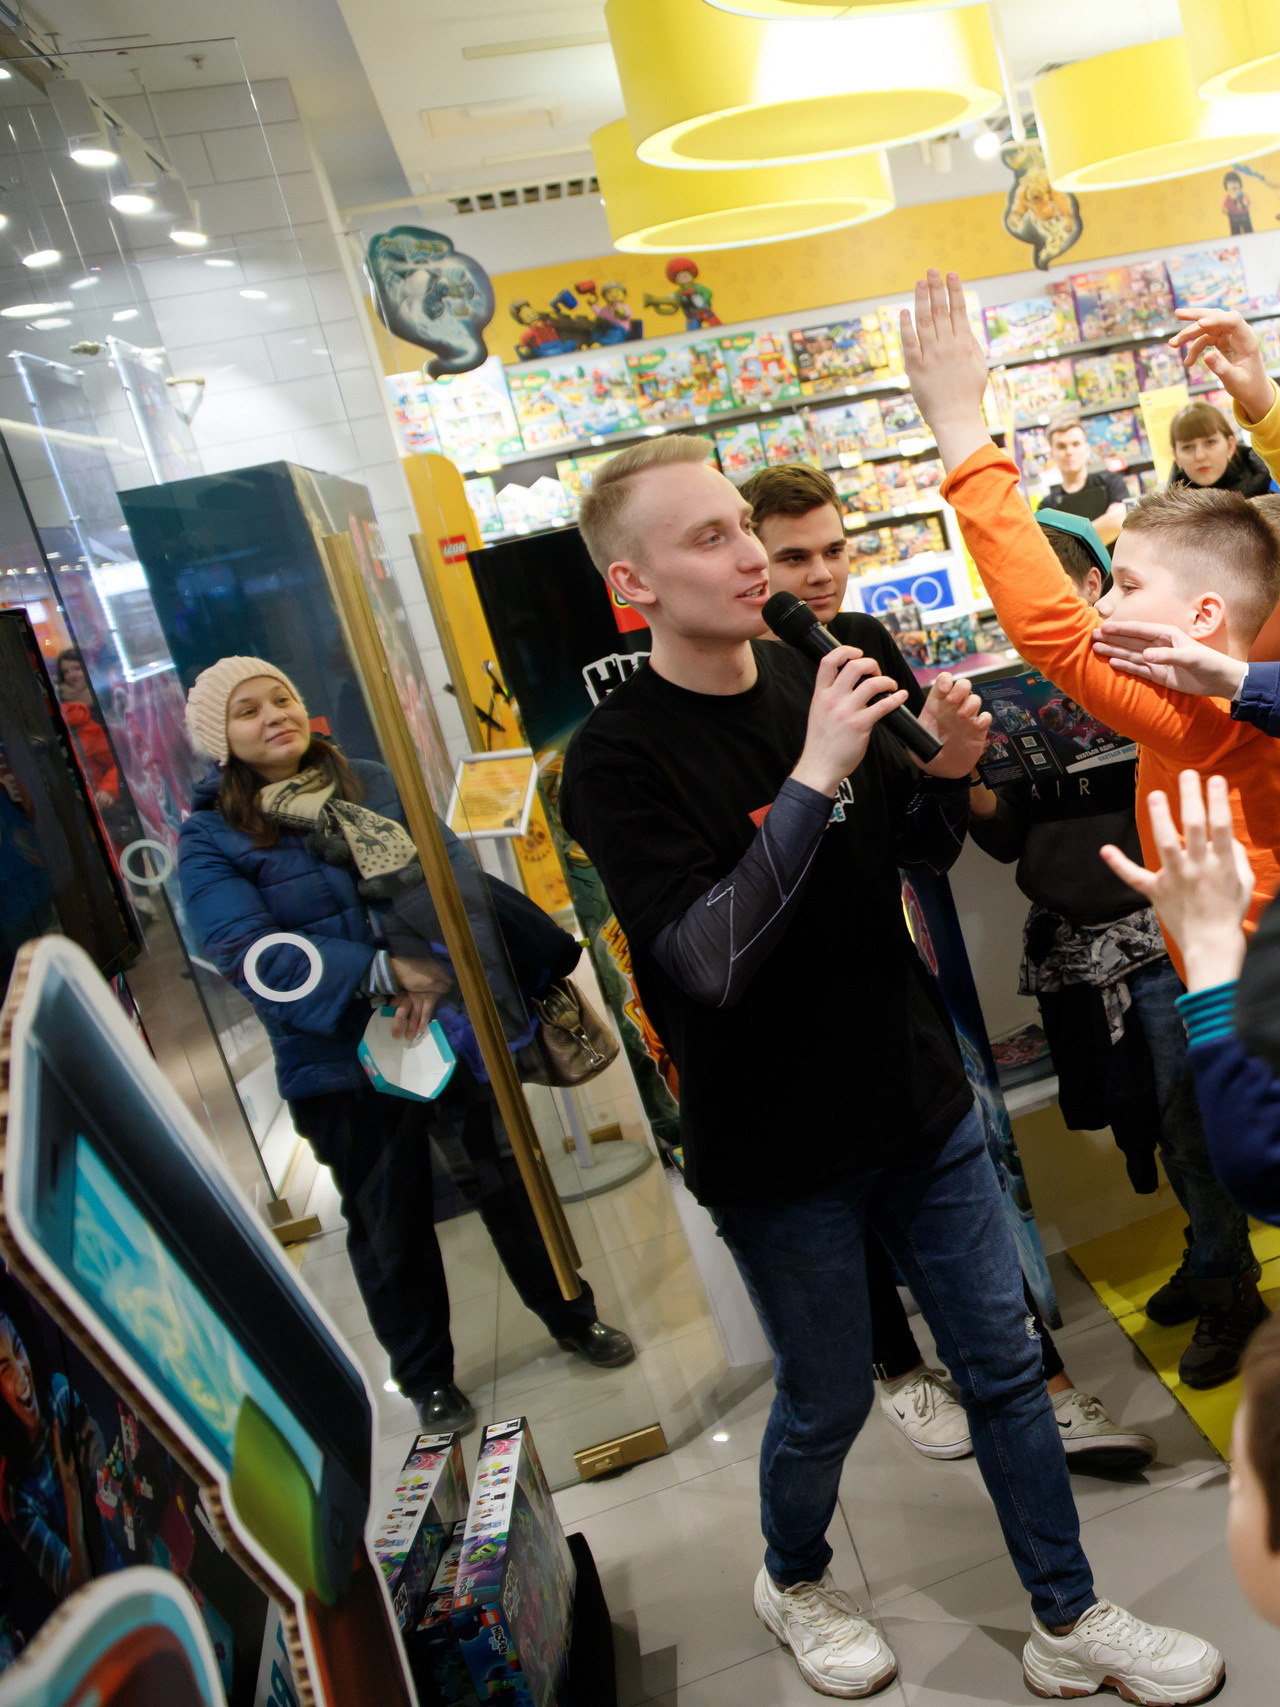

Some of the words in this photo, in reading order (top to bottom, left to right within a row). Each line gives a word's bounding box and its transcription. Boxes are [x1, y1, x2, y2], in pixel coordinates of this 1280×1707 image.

[443, 542, 467, 557] LEGO
[1121, 744, 1137, 754] ВМЕС
[491, 1625, 509, 1654] HIDDEN
